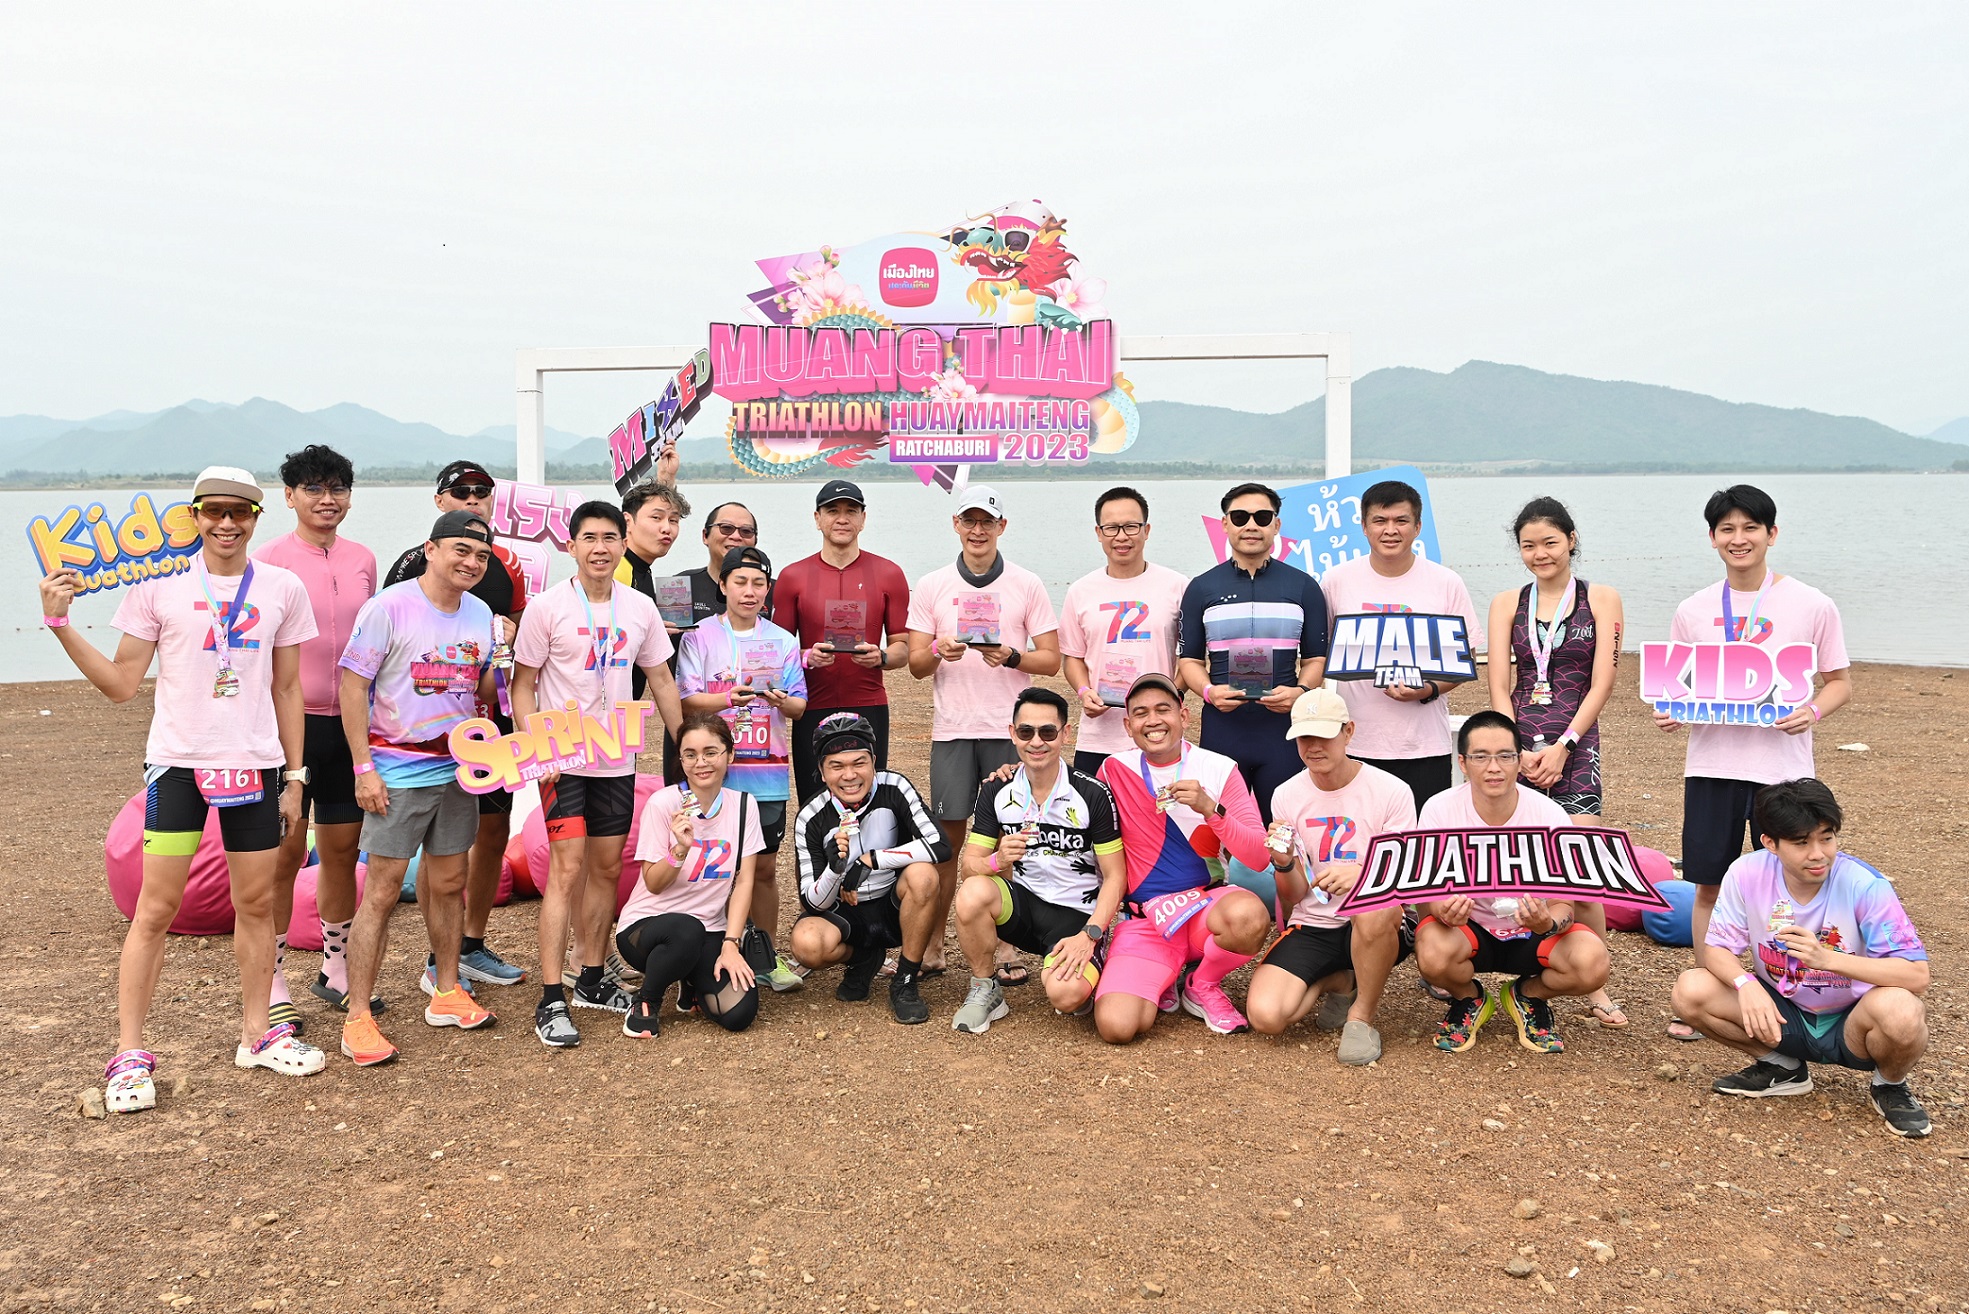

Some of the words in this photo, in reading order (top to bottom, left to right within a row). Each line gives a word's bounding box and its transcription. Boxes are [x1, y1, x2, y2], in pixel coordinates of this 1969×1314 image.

[883, 263, 935, 278] เมืองไทย
[710, 321, 948, 396] MUANG
[955, 319, 1117, 397] THAI
[608, 348, 713, 492] MIXED
[734, 401, 886, 437] TRIATHLON
[889, 399, 1090, 432] HUAYMAITENG
[895, 440, 991, 457] RATCHABURI
[1003, 432, 1090, 461] 2023
[33, 495, 203, 573] Kids
[73, 555, 191, 595] duathlon
[193, 601, 260, 651] 72
[1099, 600, 1151, 643] 72
[577, 627, 628, 670] 72
[1328, 616, 1473, 674] MALE
[1375, 666, 1423, 687] TEAM
[1644, 644, 1812, 702] KIDS
[1655, 701, 1794, 725] TRIATHLON
[201, 768, 259, 789] 2161
[520, 749, 587, 780] TRIATHLON
[1306, 815, 1357, 862] 72
[688, 839, 731, 882] 72
[1357, 834, 1648, 897] DUATHLON
[1154, 890, 1201, 926] 4009
